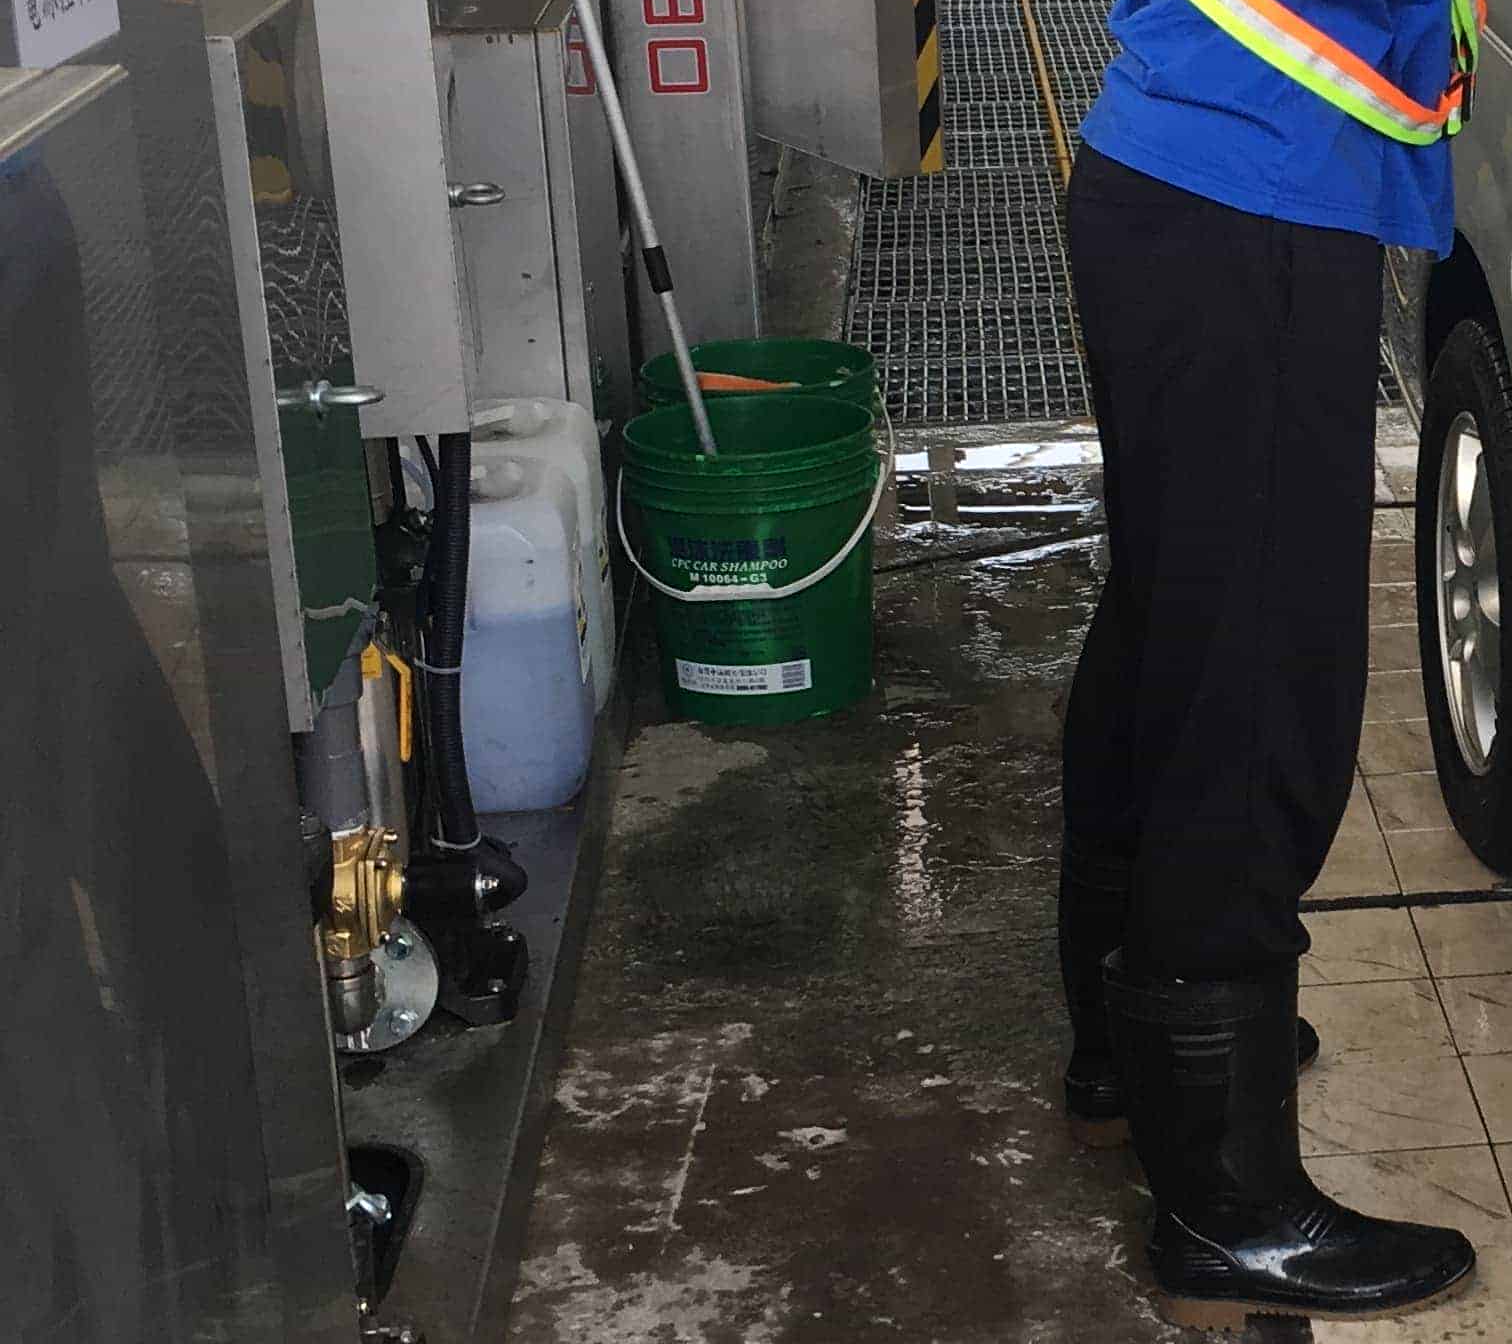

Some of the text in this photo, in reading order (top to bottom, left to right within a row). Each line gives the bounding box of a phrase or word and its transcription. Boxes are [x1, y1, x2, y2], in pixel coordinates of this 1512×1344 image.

[672, 558, 789, 573] CPC CAR SHAMPOO
